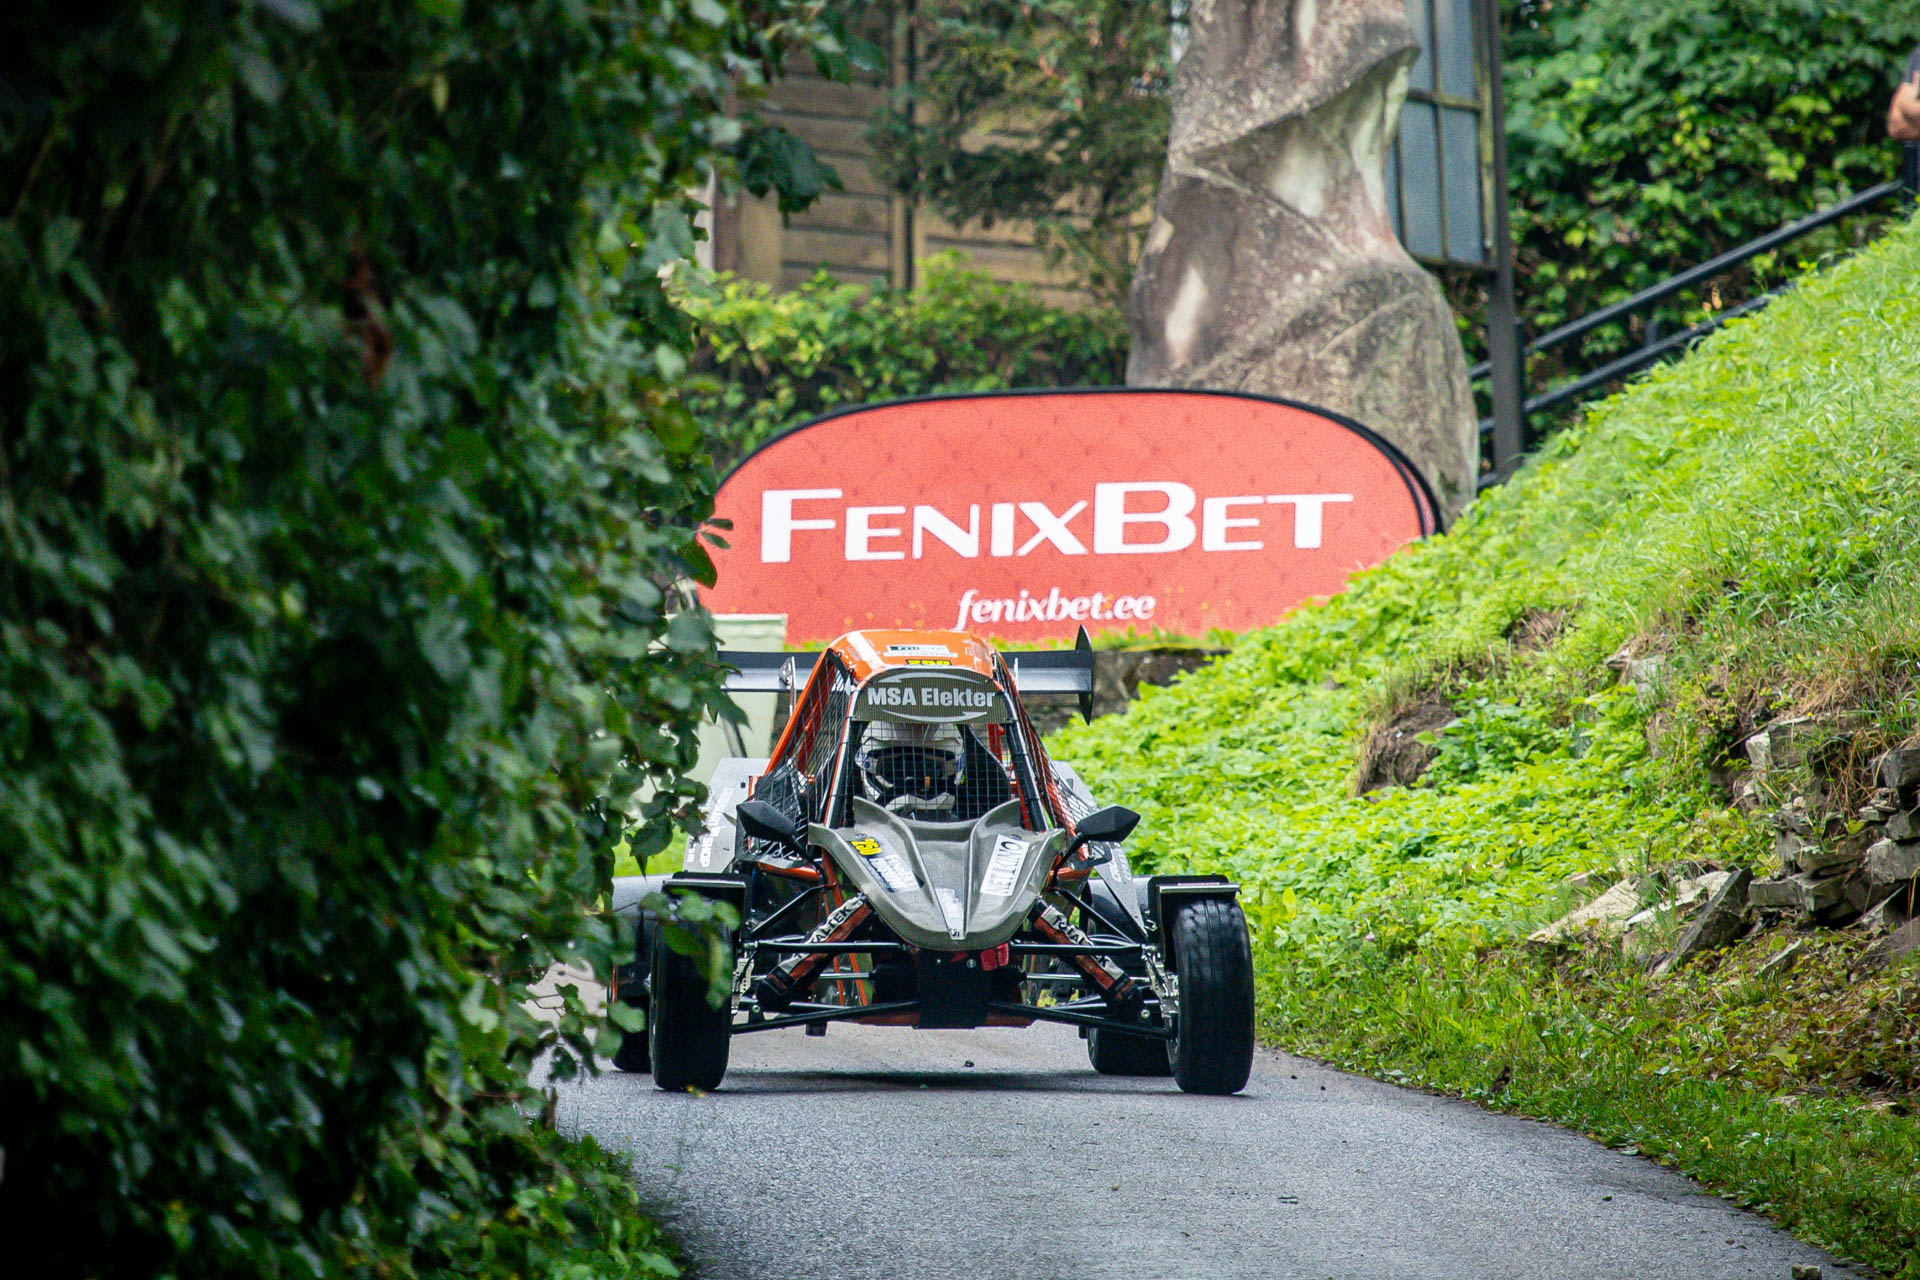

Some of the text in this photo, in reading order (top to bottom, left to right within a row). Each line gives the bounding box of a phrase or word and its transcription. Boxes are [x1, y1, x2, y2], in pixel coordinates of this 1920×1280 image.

[954, 587, 1156, 632] fenixbet.ee
[867, 687, 996, 707] MSA Elekter
